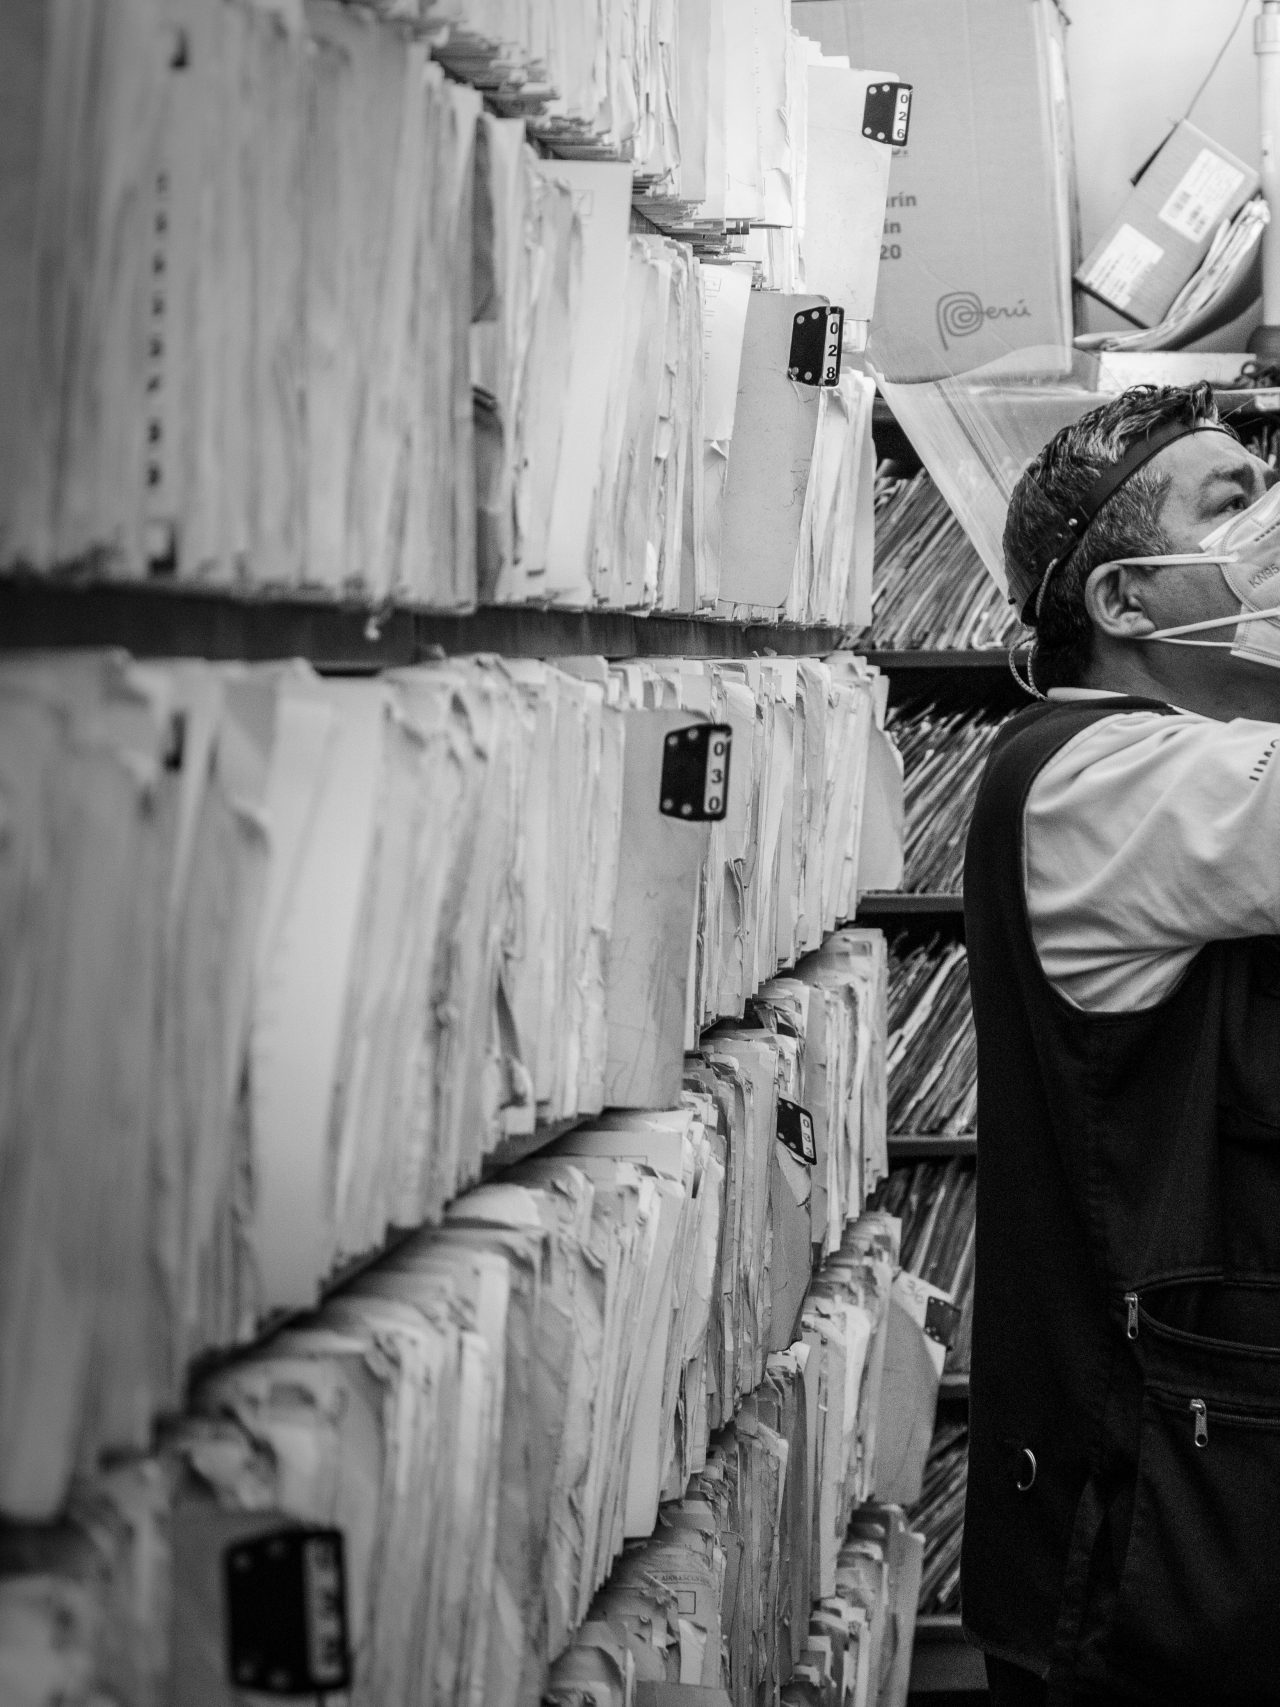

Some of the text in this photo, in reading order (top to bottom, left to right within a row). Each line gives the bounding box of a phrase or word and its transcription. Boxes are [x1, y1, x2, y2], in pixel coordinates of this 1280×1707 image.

[896, 94, 909, 139] 026
[826, 321, 839, 379] 028
[1248, 563, 1280, 589] KN95
[708, 741, 725, 812] 030
